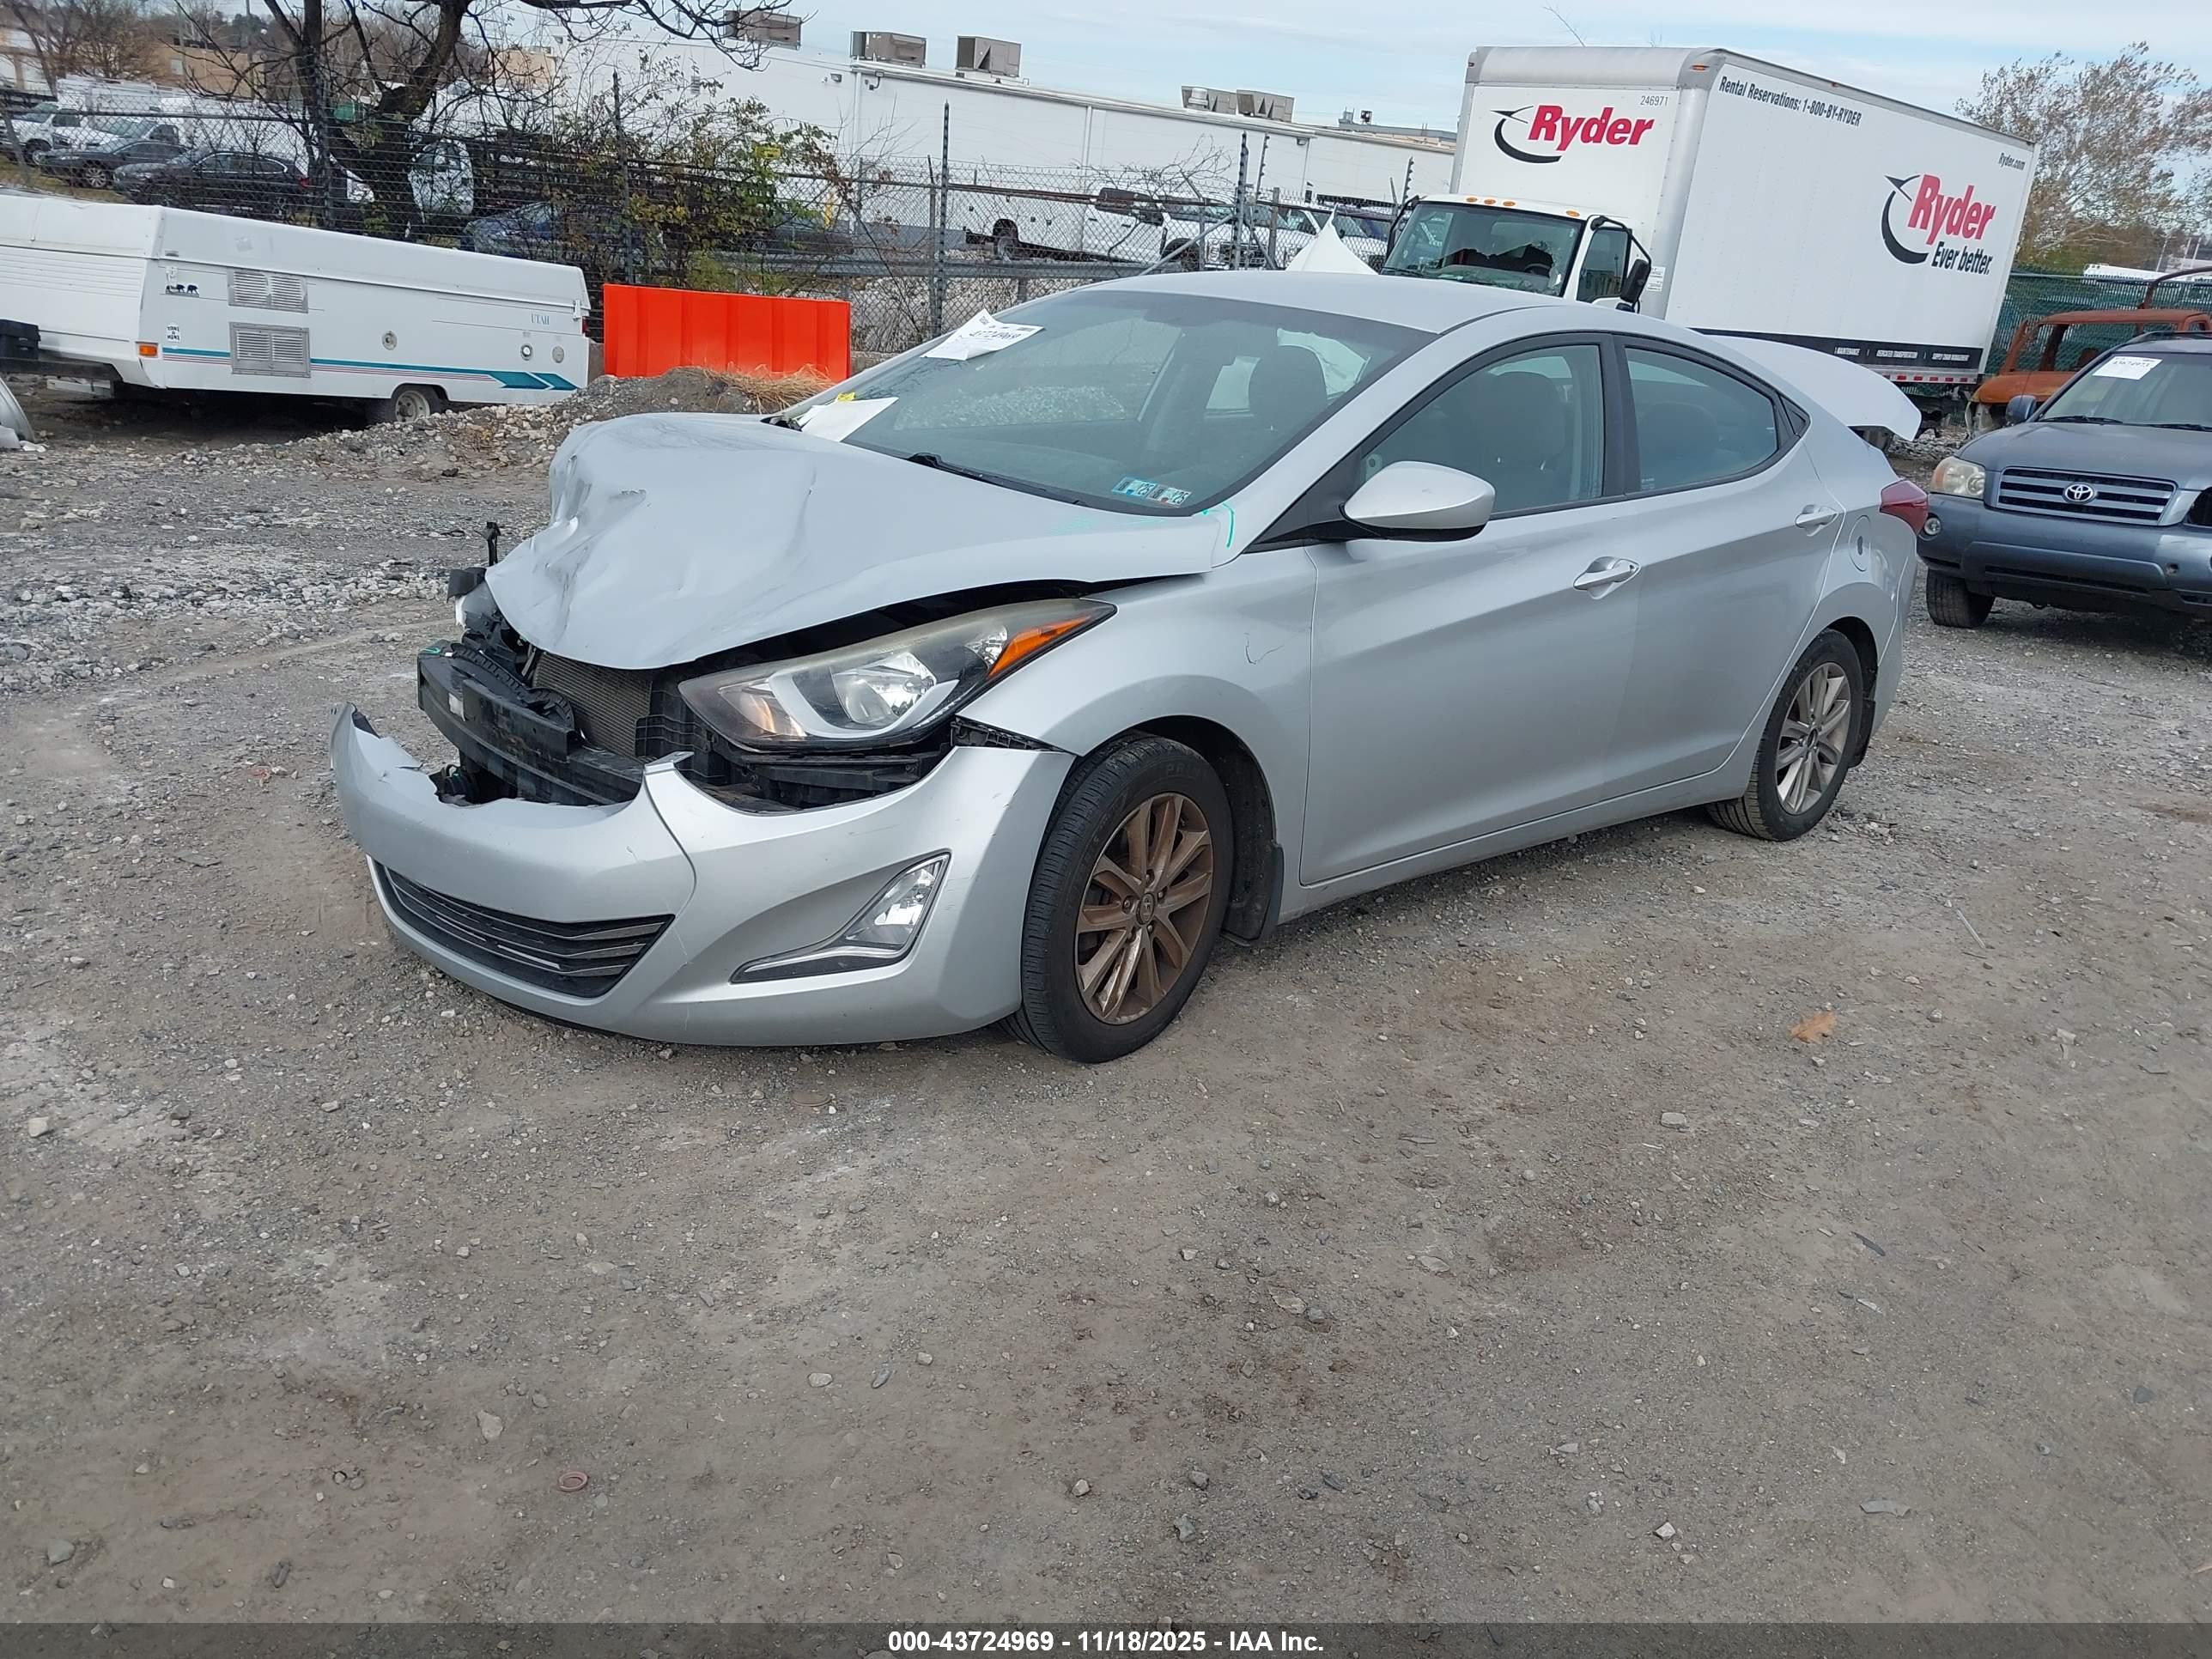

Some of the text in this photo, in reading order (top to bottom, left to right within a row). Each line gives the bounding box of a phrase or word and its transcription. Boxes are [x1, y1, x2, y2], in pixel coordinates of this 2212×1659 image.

[1640, 95, 1668, 106] 246971
[1718, 76, 1862, 126] Rental Reservations: 1-800-BY-RYDER
[1528, 105, 1655, 151] Ryder
[1997, 152, 2026, 171] Ryder.com
[1907, 174, 1996, 246] Ryder
[1931, 240, 1993, 275] Ever better.
